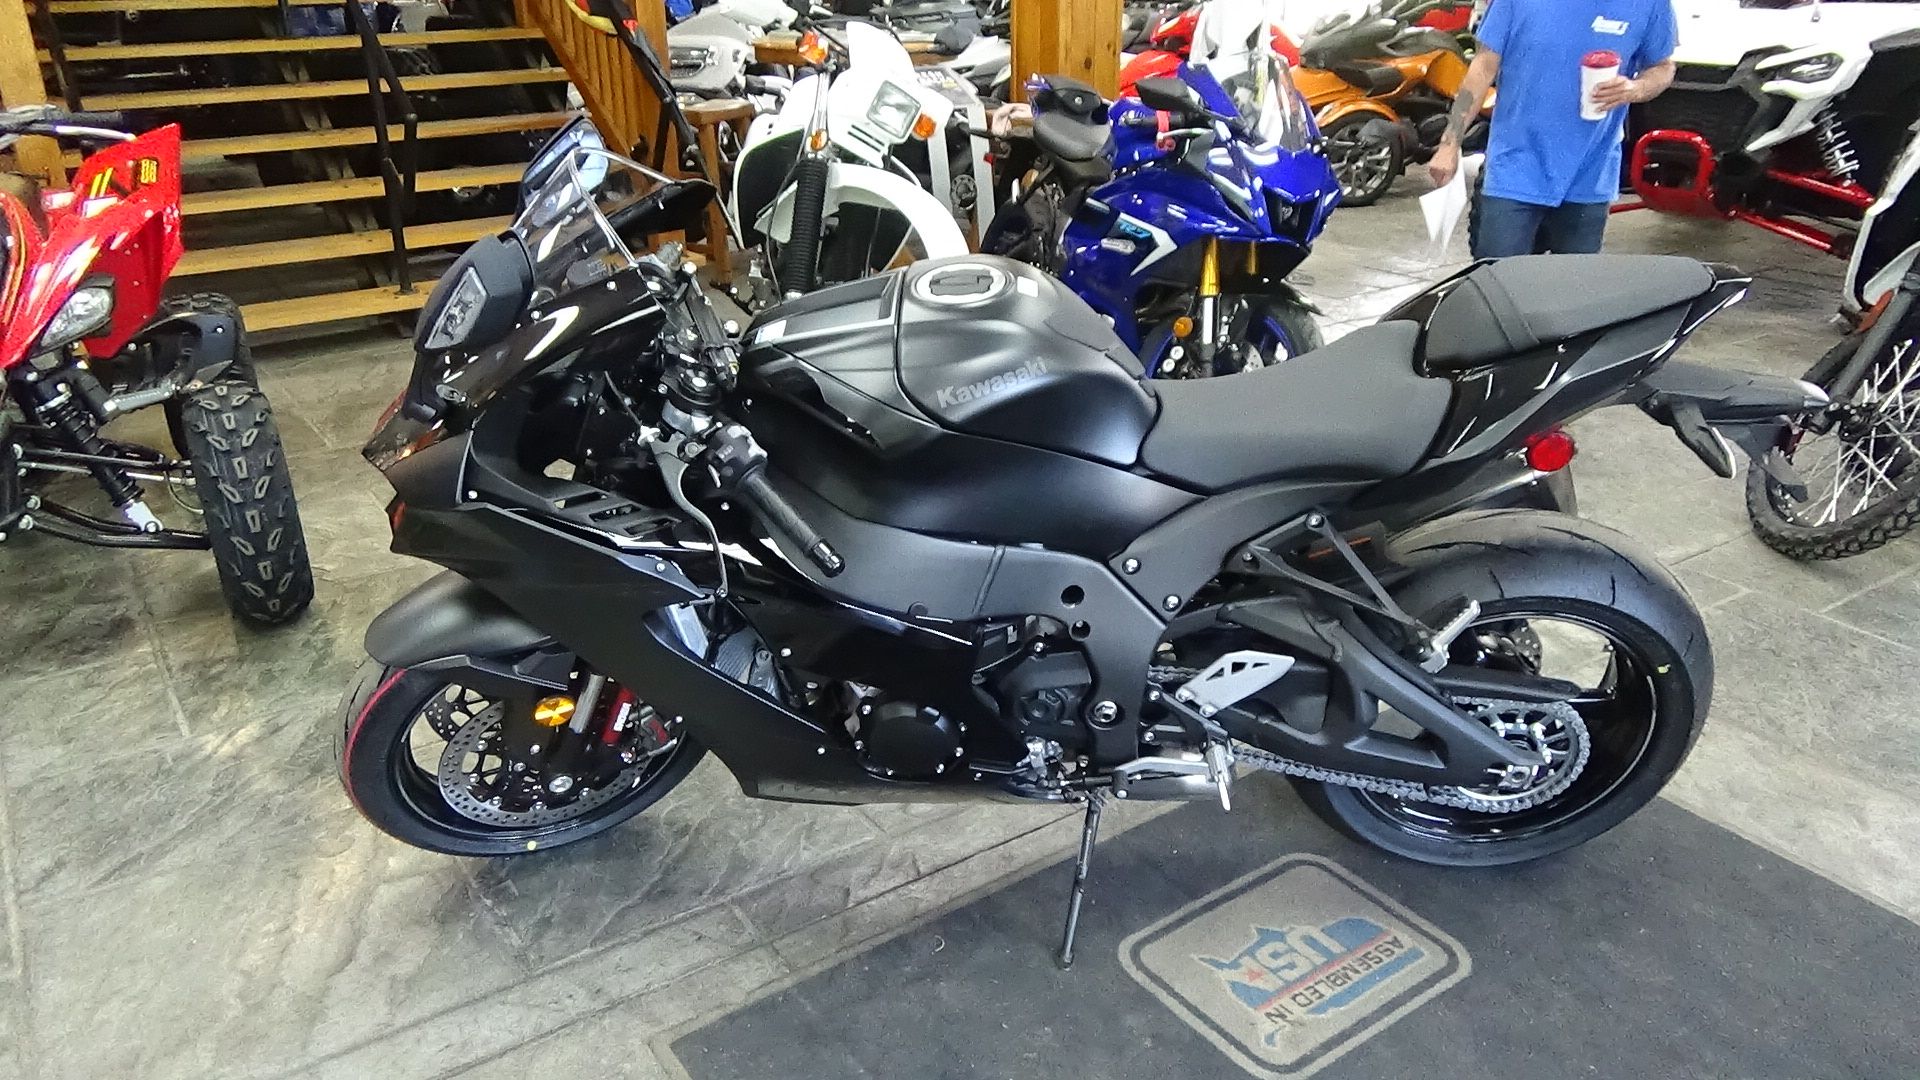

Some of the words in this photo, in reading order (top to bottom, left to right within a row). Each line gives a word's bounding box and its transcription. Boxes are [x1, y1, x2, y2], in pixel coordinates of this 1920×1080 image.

[936, 356, 1048, 409] Kawasaki
[1220, 925, 1348, 991] USA
[1290, 935, 1404, 1008] ASSEMBLED
[1263, 1003, 1294, 1025] IN
